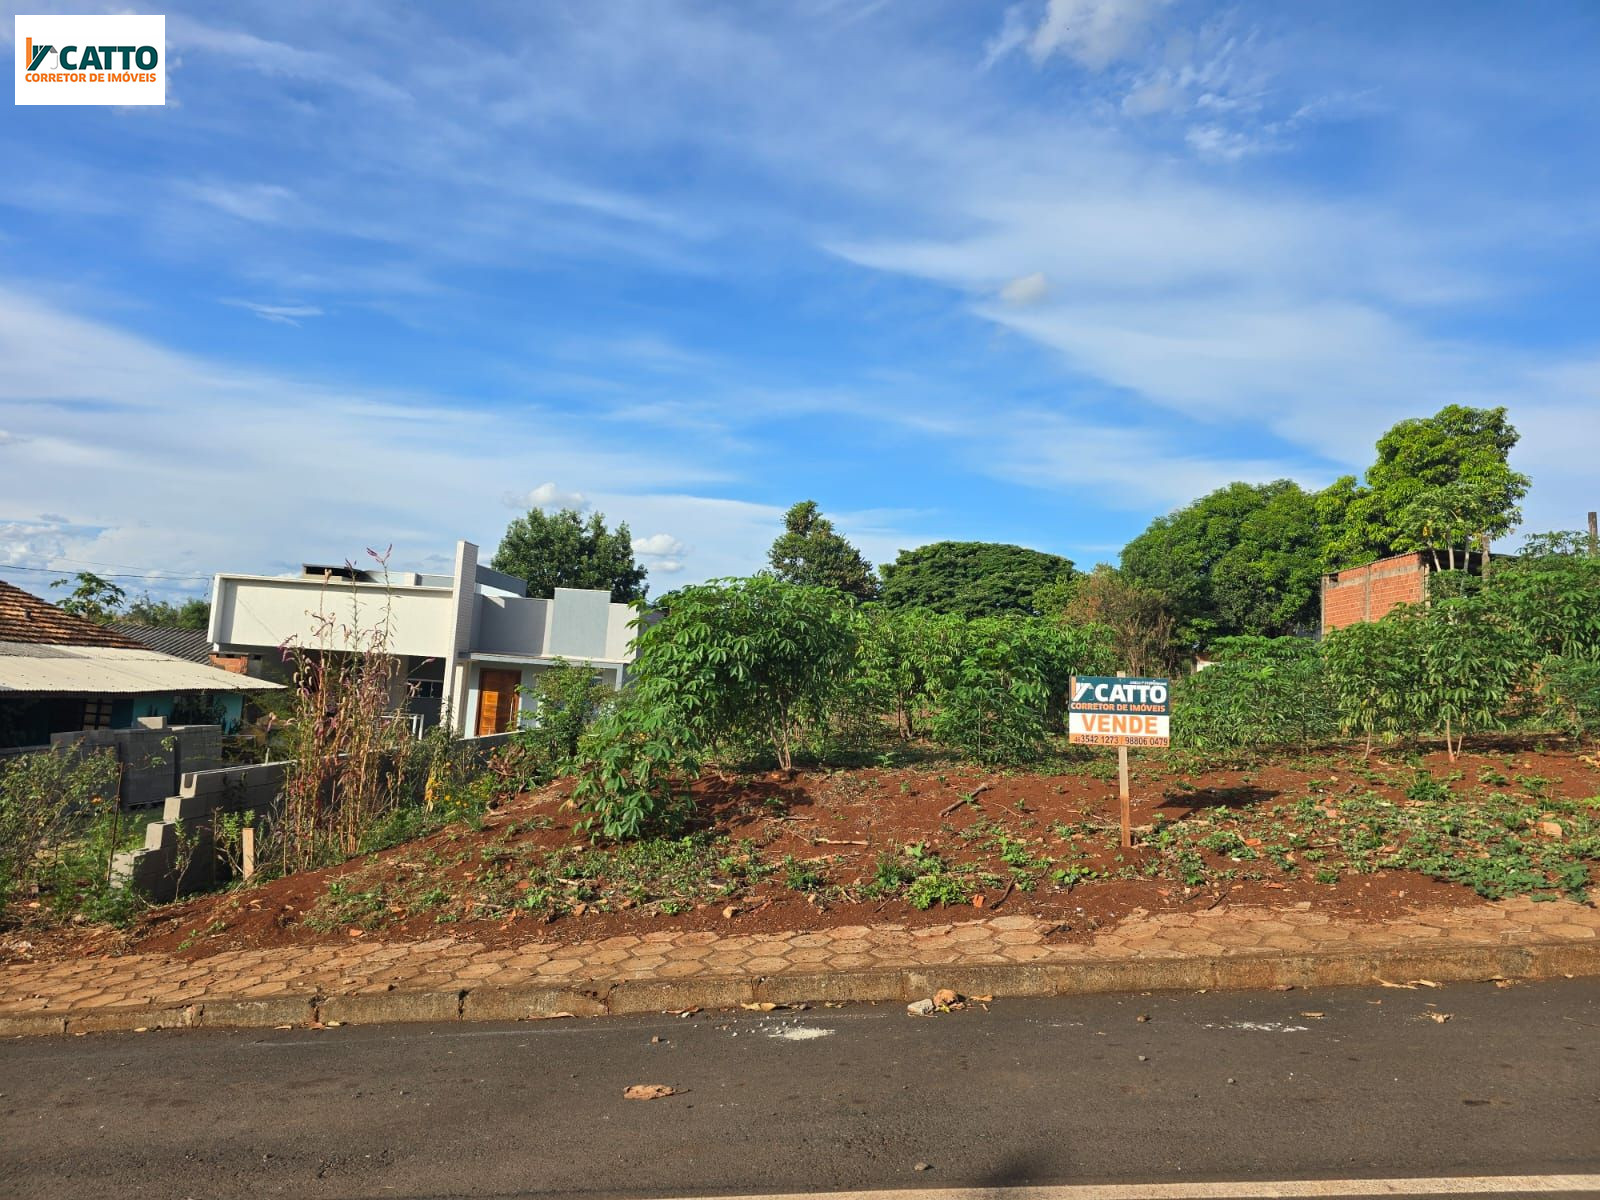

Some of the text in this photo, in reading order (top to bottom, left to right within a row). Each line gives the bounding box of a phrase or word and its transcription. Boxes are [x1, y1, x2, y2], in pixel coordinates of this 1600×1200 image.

[1094, 683, 1167, 704] CATTO
[1070, 702, 1166, 713] CORRETOR DE IMÓVEIS
[1081, 713, 1158, 735] VENDE
[1101, 735, 1119, 744] 1273
[1149, 737, 1168, 746] 0479
